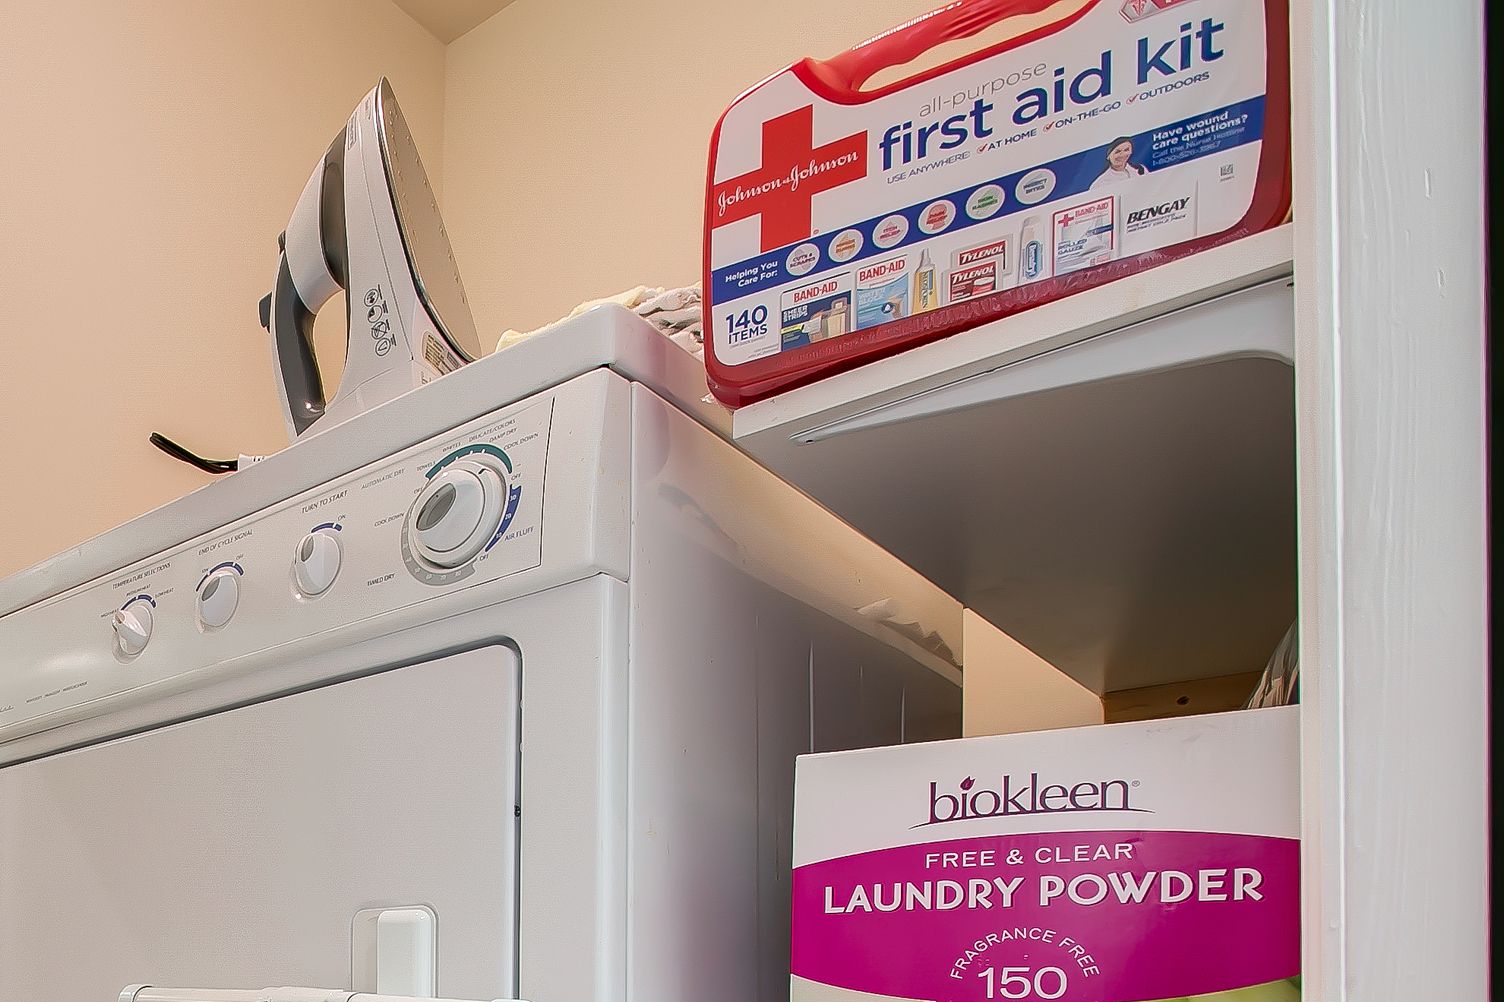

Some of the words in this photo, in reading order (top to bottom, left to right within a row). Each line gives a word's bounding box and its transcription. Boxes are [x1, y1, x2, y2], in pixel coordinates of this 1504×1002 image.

[879, 98, 994, 171] first
[1012, 50, 1112, 125] aid
[1137, 17, 1225, 85] kit
[919, 62, 1048, 117] all-purpose
[887, 171, 906, 184] USE
[988, 140, 1002, 151] AT
[1004, 128, 1038, 145] HOME
[1055, 101, 1121, 128] ON-THE-GO
[1139, 71, 1210, 101] OUTDOORS
[1152, 138, 1178, 150] care
[1181, 114, 1248, 142] questions?
[1153, 126, 1184, 142] Have
[1186, 111, 1229, 130] wound
[1126, 196, 1191, 224] BENGAY
[960, 243, 1005, 264] TYLENOL
[725, 266, 758, 282] Helping
[760, 261, 778, 271] You
[738, 276, 758, 287] Care
[760, 270, 778, 281] For:
[859, 259, 906, 281] BAND-AID
[951, 265, 994, 285] TYLENOL
[793, 281, 838, 303] BAND-AID
[726, 304, 768, 333] 140
[728, 323, 768, 344] ITEMS
[468, 419, 516, 442] DELICATE/COLORS
[506, 427, 518, 436] DRY
[519, 432, 539, 444] DOWN
[361, 472, 393, 489] AUTOMATIC
[394, 468, 405, 478] DRY
[301, 501, 319, 514] TURN
[319, 498, 329, 507] TO
[328, 489, 348, 504] START
[504, 532, 515, 542] AIR
[112, 572, 144, 590] TEMPERATURE
[384, 572, 396, 581] DRY
[928, 772, 1131, 824] biokleen
[925, 849, 996, 869] FREE
[1005, 847, 1025, 866] &
[1034, 843, 1134, 864] CLEAR
[823, 876, 1024, 915] LAUNDRY
[1040, 866, 1264, 908] POWDER
[949, 926, 1057, 980] FRAGRANCE
[1058, 936, 1100, 978] FREE
[977, 966, 1068, 1000] 150
